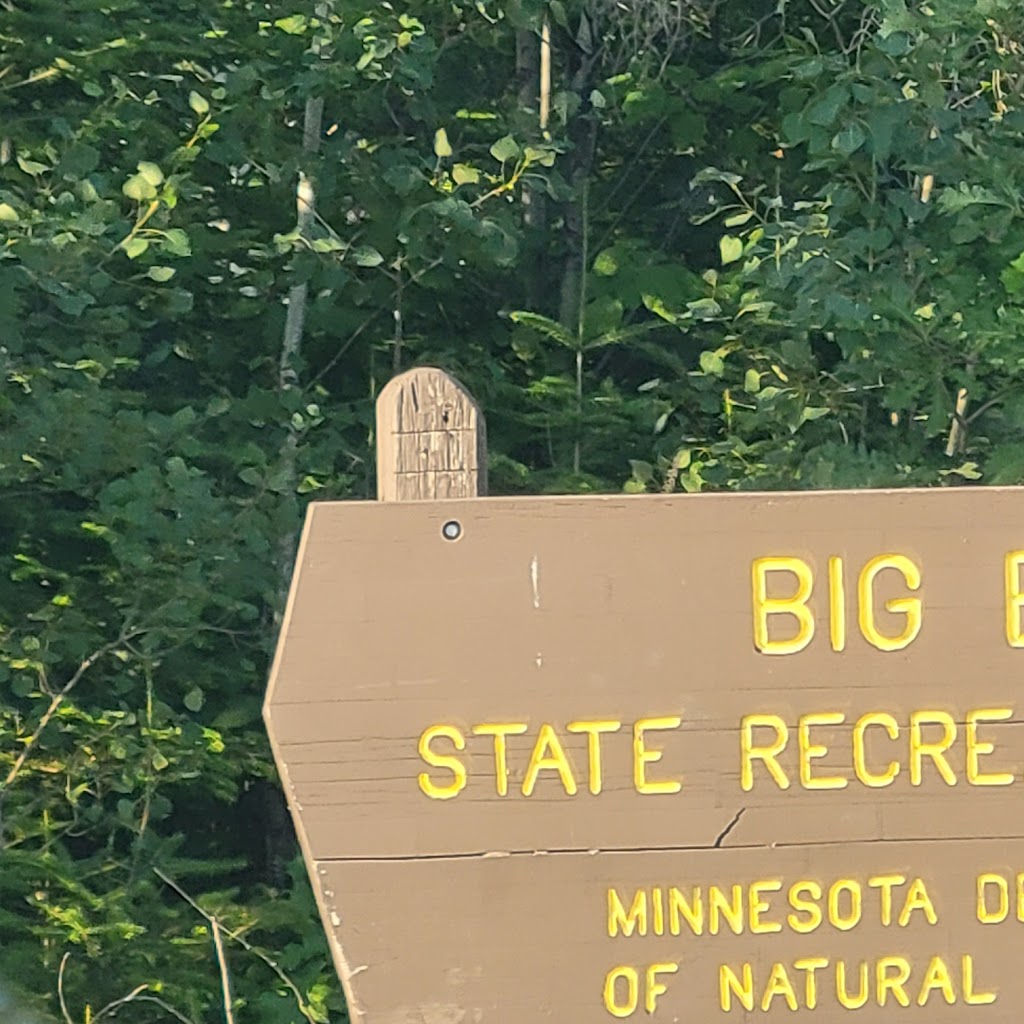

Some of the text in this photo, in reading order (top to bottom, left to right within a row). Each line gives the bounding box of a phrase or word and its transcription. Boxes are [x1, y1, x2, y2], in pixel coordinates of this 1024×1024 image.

[750, 552, 922, 655] BIG
[417, 714, 682, 800] STATE
[606, 872, 938, 938] MINNESOTA
[602, 960, 679, 1018] OF
[718, 953, 995, 1013] NATURAL
